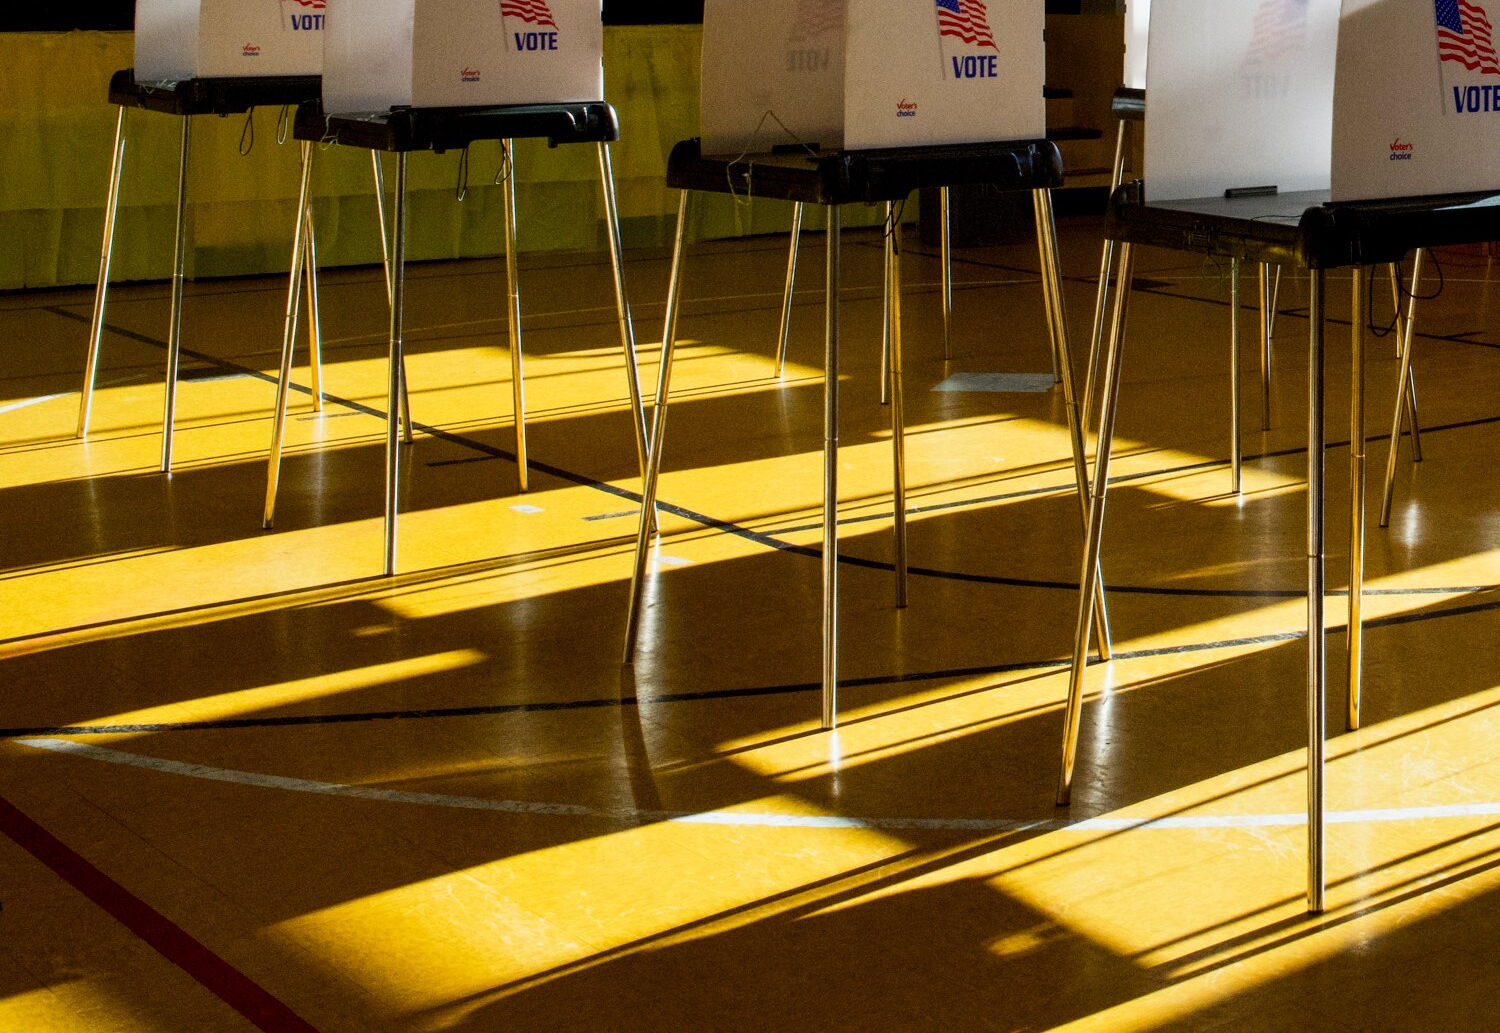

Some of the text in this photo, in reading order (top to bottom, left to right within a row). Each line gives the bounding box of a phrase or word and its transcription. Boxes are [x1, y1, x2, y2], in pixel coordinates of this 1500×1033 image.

[291, 14, 325, 31] VOT
[514, 32, 557, 51] VOTE
[952, 55, 998, 79] VOTE
[897, 98, 918, 110] Voter's
[896, 109, 917, 117] choice
[1389, 138, 1413, 151] Voter's
[1389, 151, 1412, 161] choice
